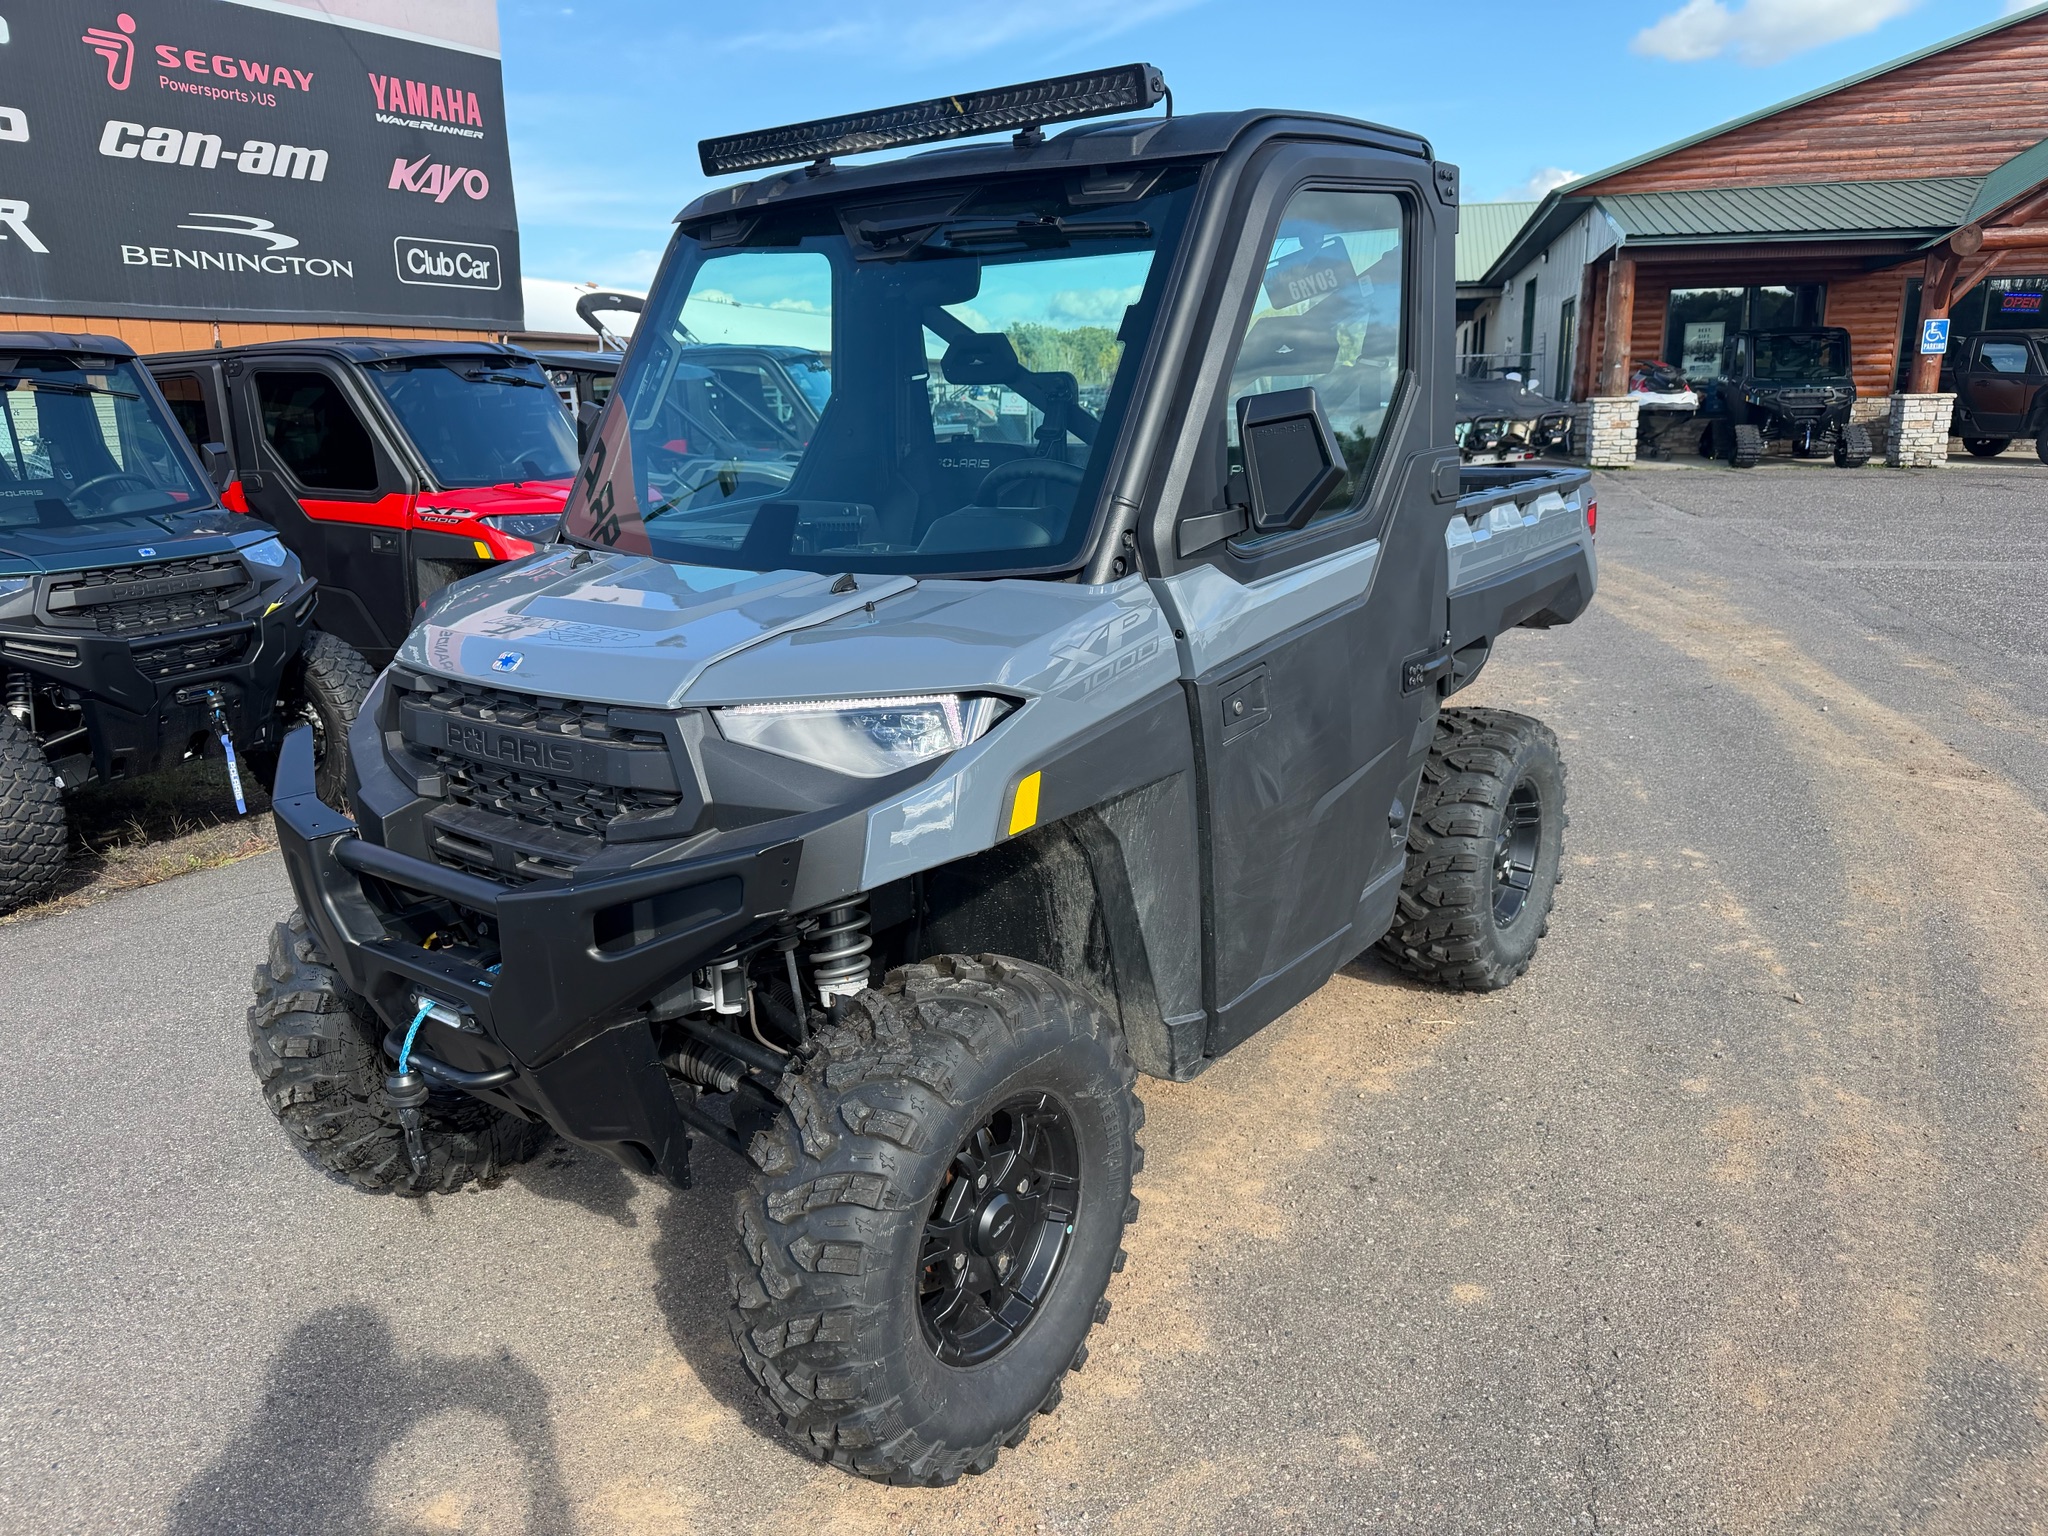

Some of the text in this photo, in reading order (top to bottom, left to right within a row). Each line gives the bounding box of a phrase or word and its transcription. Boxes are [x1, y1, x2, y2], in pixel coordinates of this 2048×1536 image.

[155, 44, 314, 92] SEGWAY
[368, 72, 483, 127] YAMAHA
[99, 119, 329, 183] can-am
[121, 245, 354, 279] BENNINGTON
[2002, 297, 2042, 308] OPEN
[1923, 342, 1945, 350] PARKING
[420, 505, 472, 516] XP
[422, 516, 460, 525] 1000
[112, 578, 203, 600] POLARIS
[1048, 602, 1154, 690] XP
[1083, 635, 1160, 694] 1000
[446, 721, 575, 773] POLARIS
